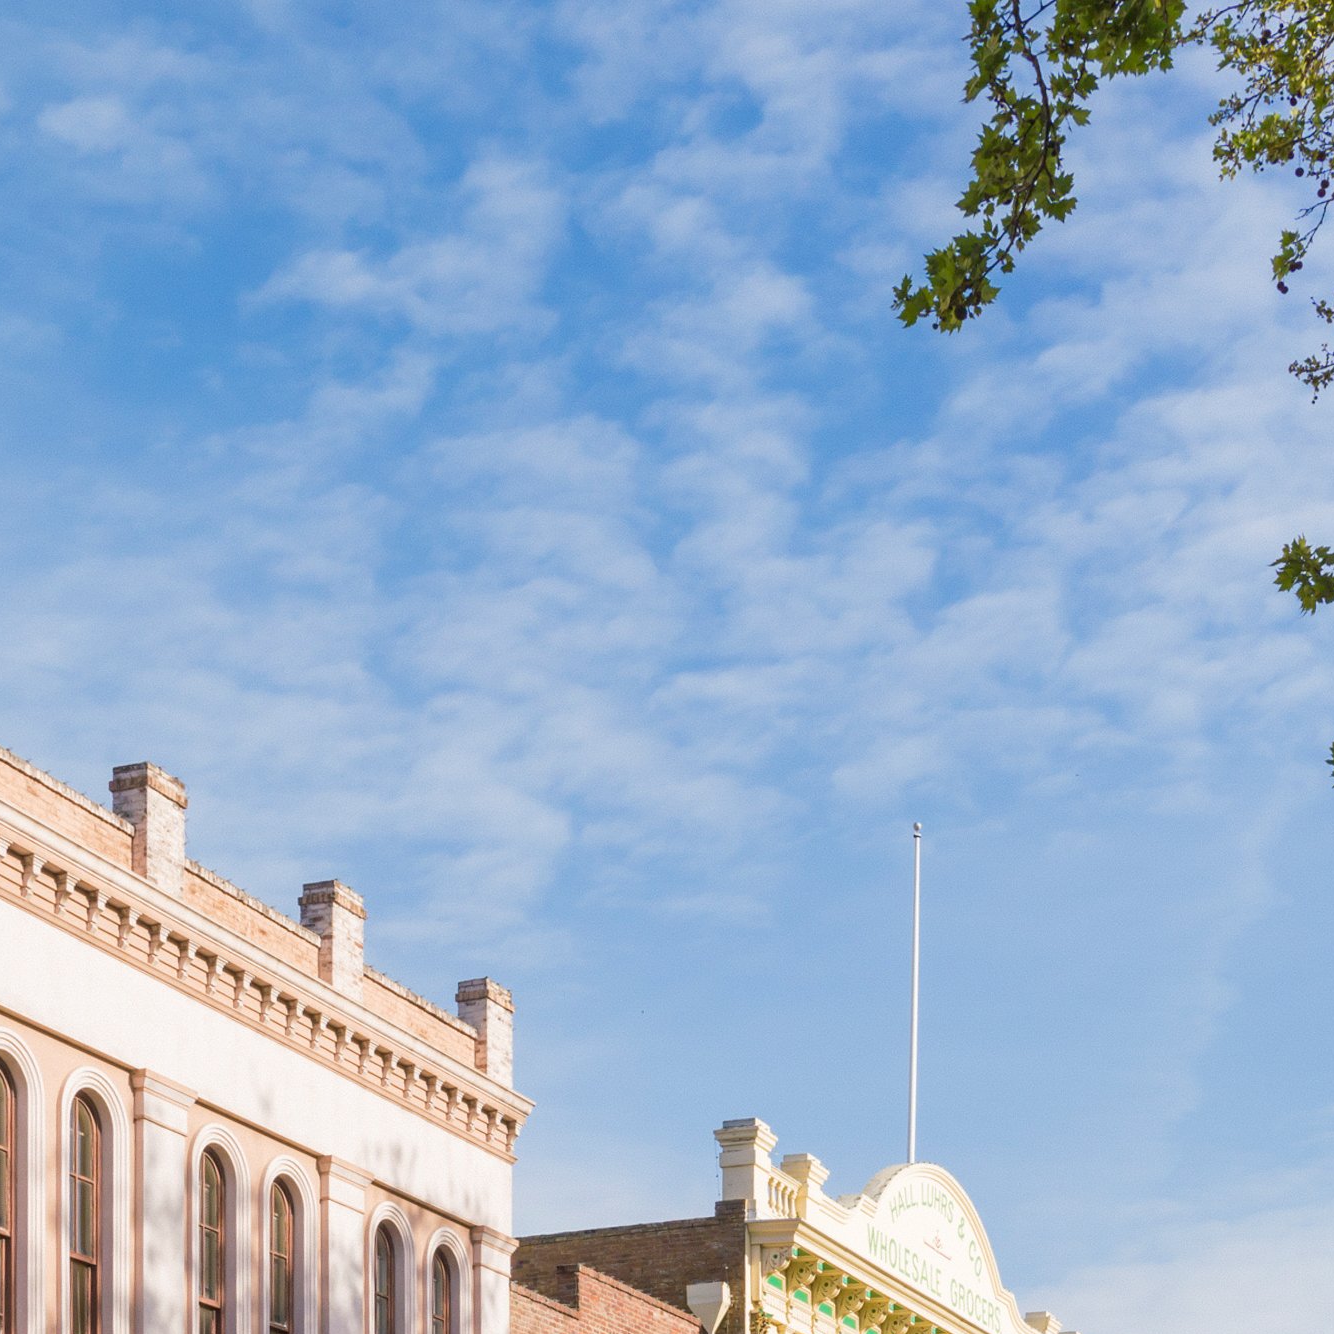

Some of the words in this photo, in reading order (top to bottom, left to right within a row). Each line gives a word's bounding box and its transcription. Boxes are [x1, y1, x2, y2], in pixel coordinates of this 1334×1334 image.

[921, 1182, 954, 1223] LUHRS
[957, 1217, 965, 1239] &
[867, 1223, 942, 1297] WHOLESALE
